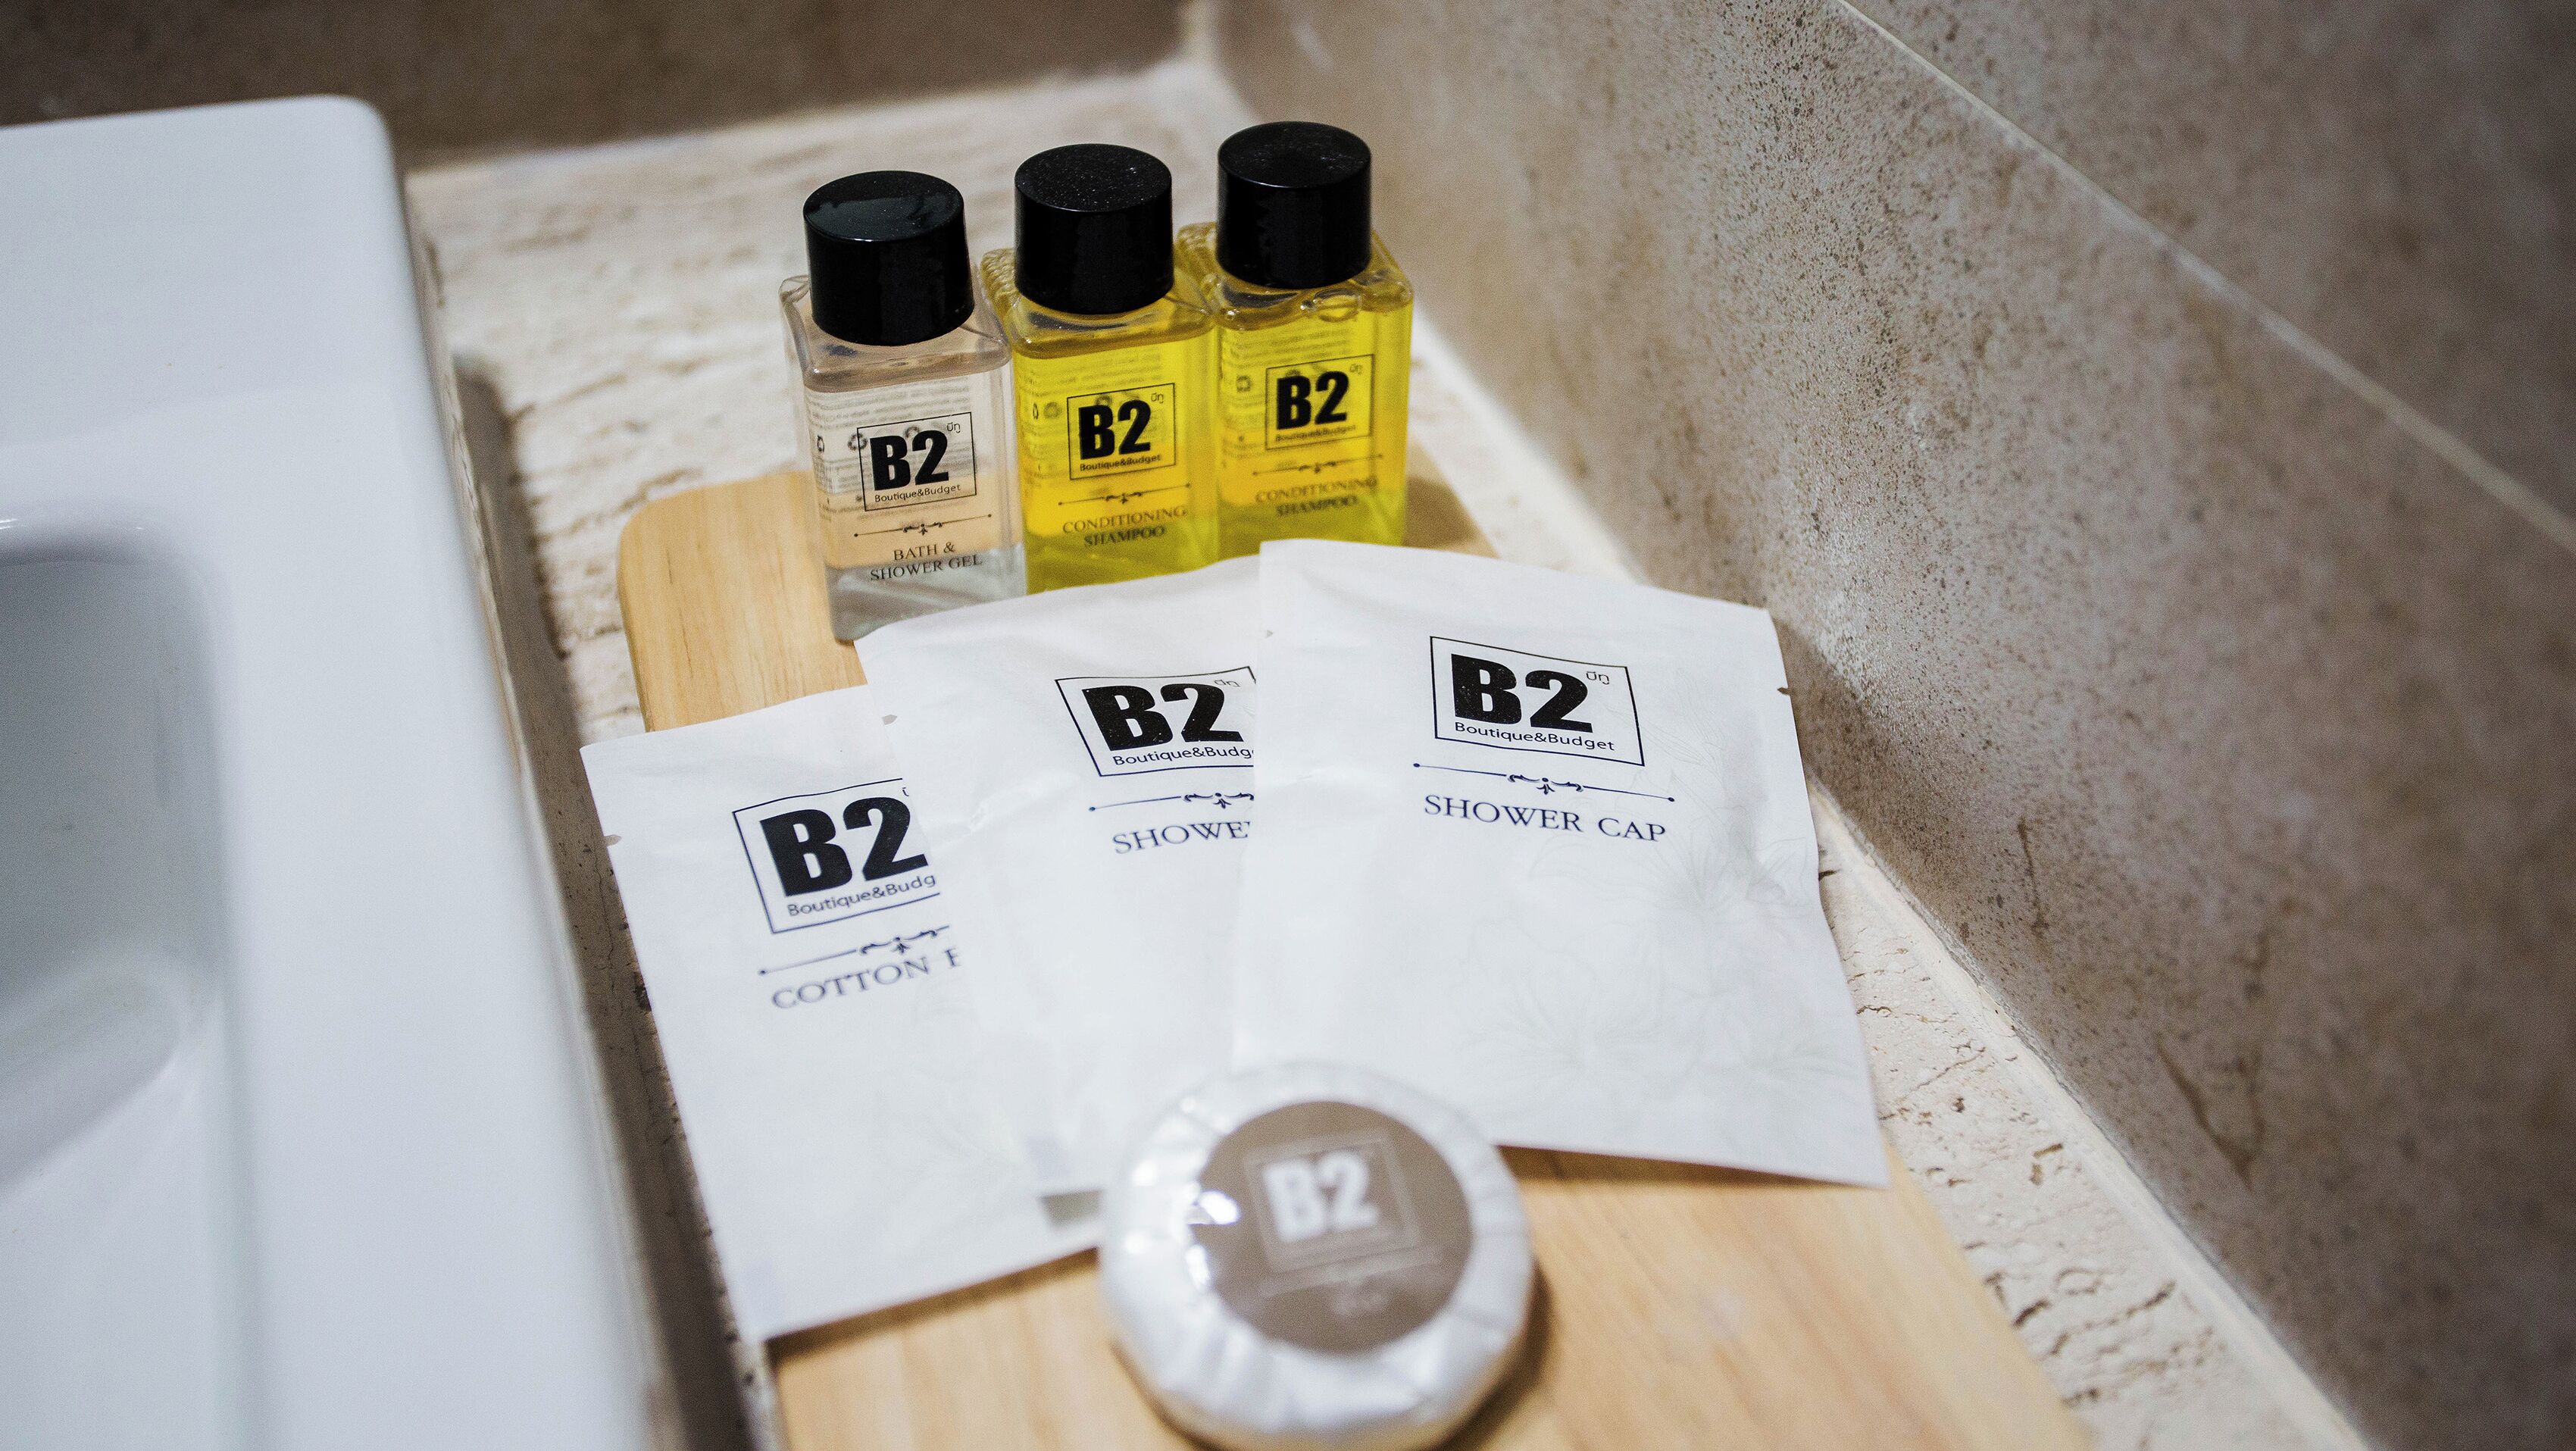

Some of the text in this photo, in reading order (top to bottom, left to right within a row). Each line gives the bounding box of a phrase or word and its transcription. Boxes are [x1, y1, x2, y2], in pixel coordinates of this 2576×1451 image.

[1276, 371, 1349, 430] B2
[1078, 399, 1152, 460] B2
[869, 430, 949, 491] B2
[1080, 454, 1161, 471] Boutique&Budget
[874, 483, 961, 503] Boutique&Budget
[1255, 476, 1378, 503] CONDITIONING
[1062, 505, 1187, 533] CONDITIONING
[1083, 525, 1166, 547] SHAMPOO
[870, 554, 983, 581] SHOWER GEL
[893, 541, 955, 561] BATH &
[1451, 653, 1593, 733] B2
[1081, 683, 1244, 752] B2
[1455, 721, 1615, 751] Boutique&Budget
[1112, 746, 1253, 765] Boutique&Budg
[1424, 793, 1666, 843] SHOWER CAP
[759, 796, 929, 897] B2
[1111, 821, 1251, 855] SHOWE
[786, 873, 936, 917] Boutique&Budg
[771, 956, 930, 1009] COTTON
[1261, 1150, 1380, 1243] B2
